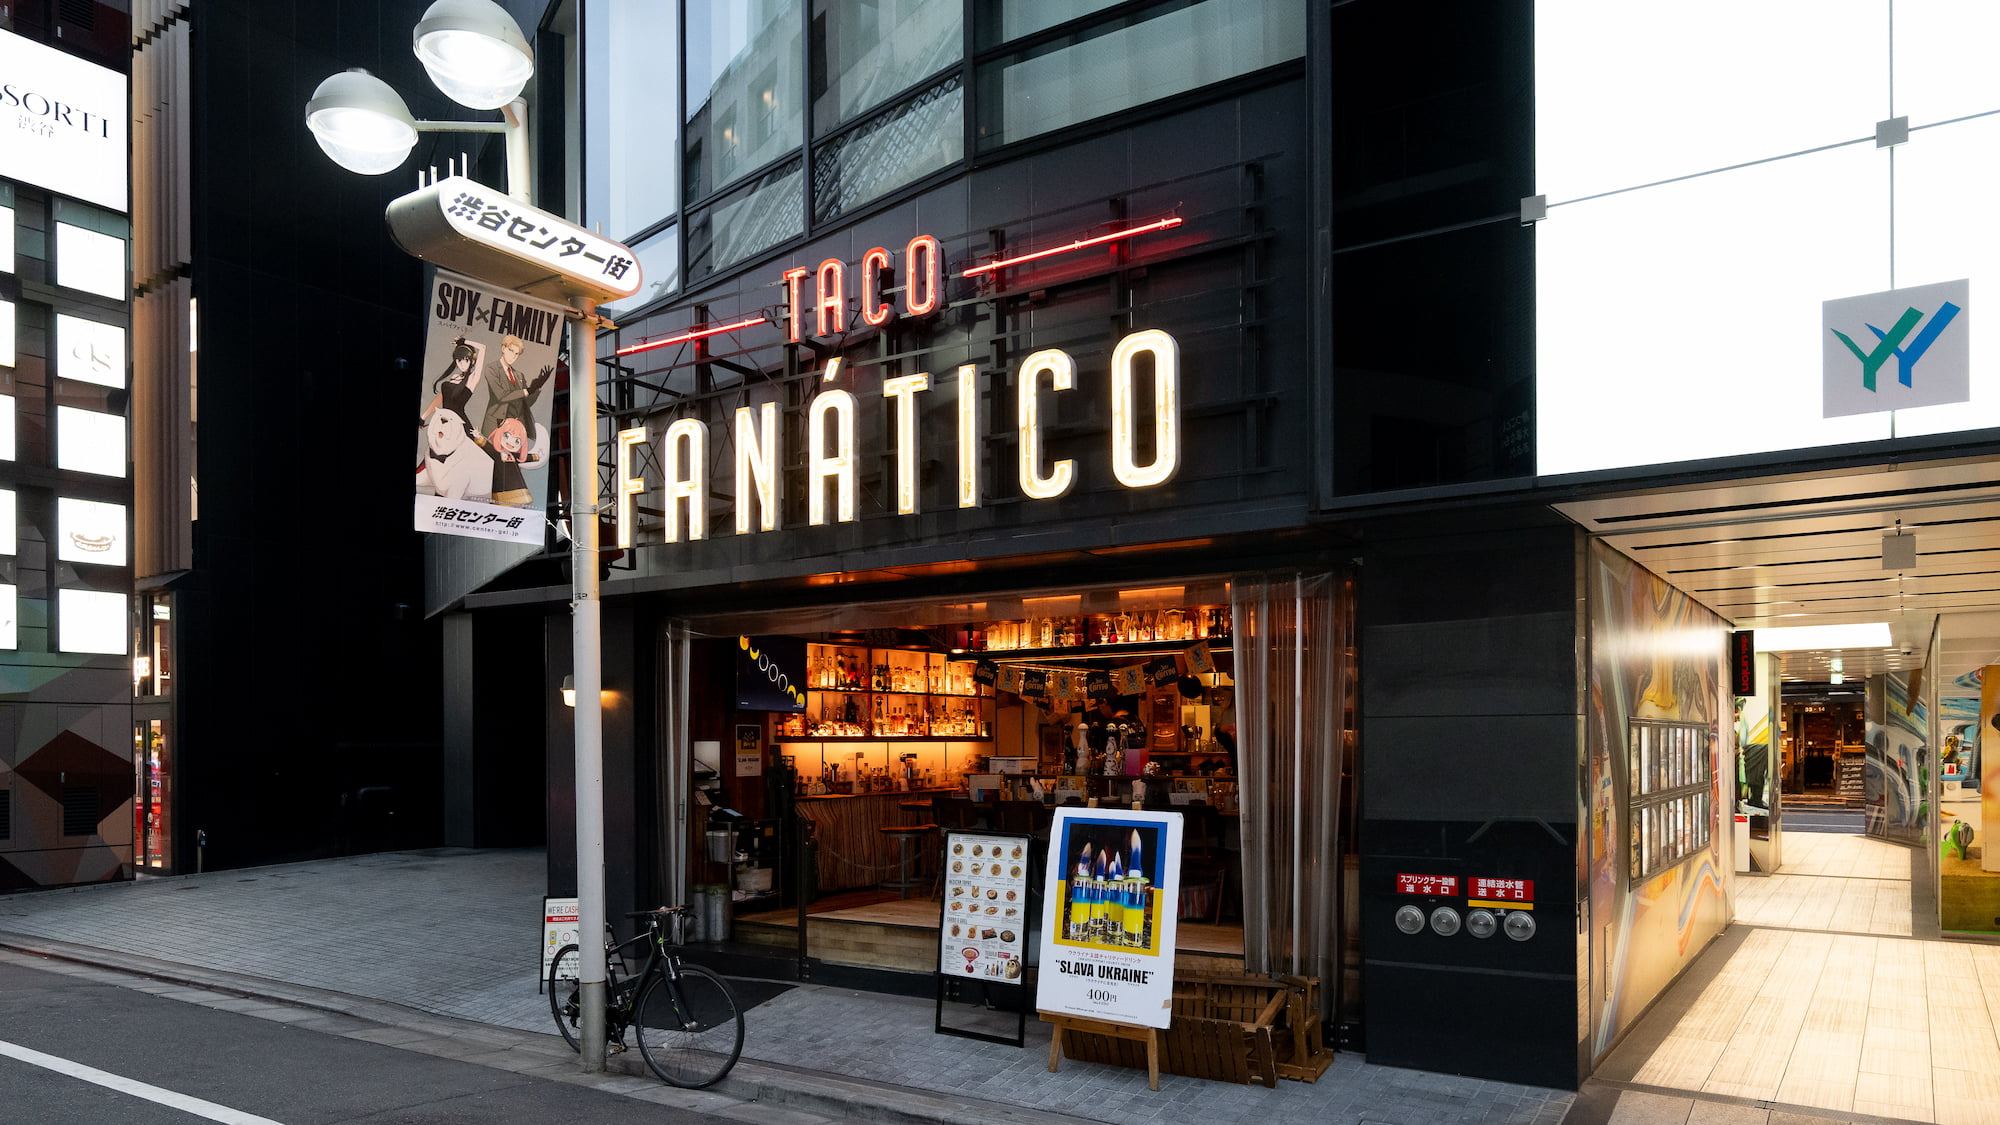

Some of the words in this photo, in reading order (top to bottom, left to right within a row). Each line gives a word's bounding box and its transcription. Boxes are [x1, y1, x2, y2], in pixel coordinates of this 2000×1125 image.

[0, 84, 109, 138] SORTI
[447, 192, 633, 281] 渋谷センター街
[783, 234, 942, 344] TACO
[616, 328, 1182, 549] FANÁTICO
[431, 506, 525, 529] 渋谷センター街
[1400, 875, 1455, 887] スプリンクラー設備
[1478, 879, 1524, 890] 連結送水管
[1056, 960, 1094, 977] "SLAVA
[1098, 965, 1154, 985] UKRAINE"
[1086, 988, 1117, 1003] 400円
